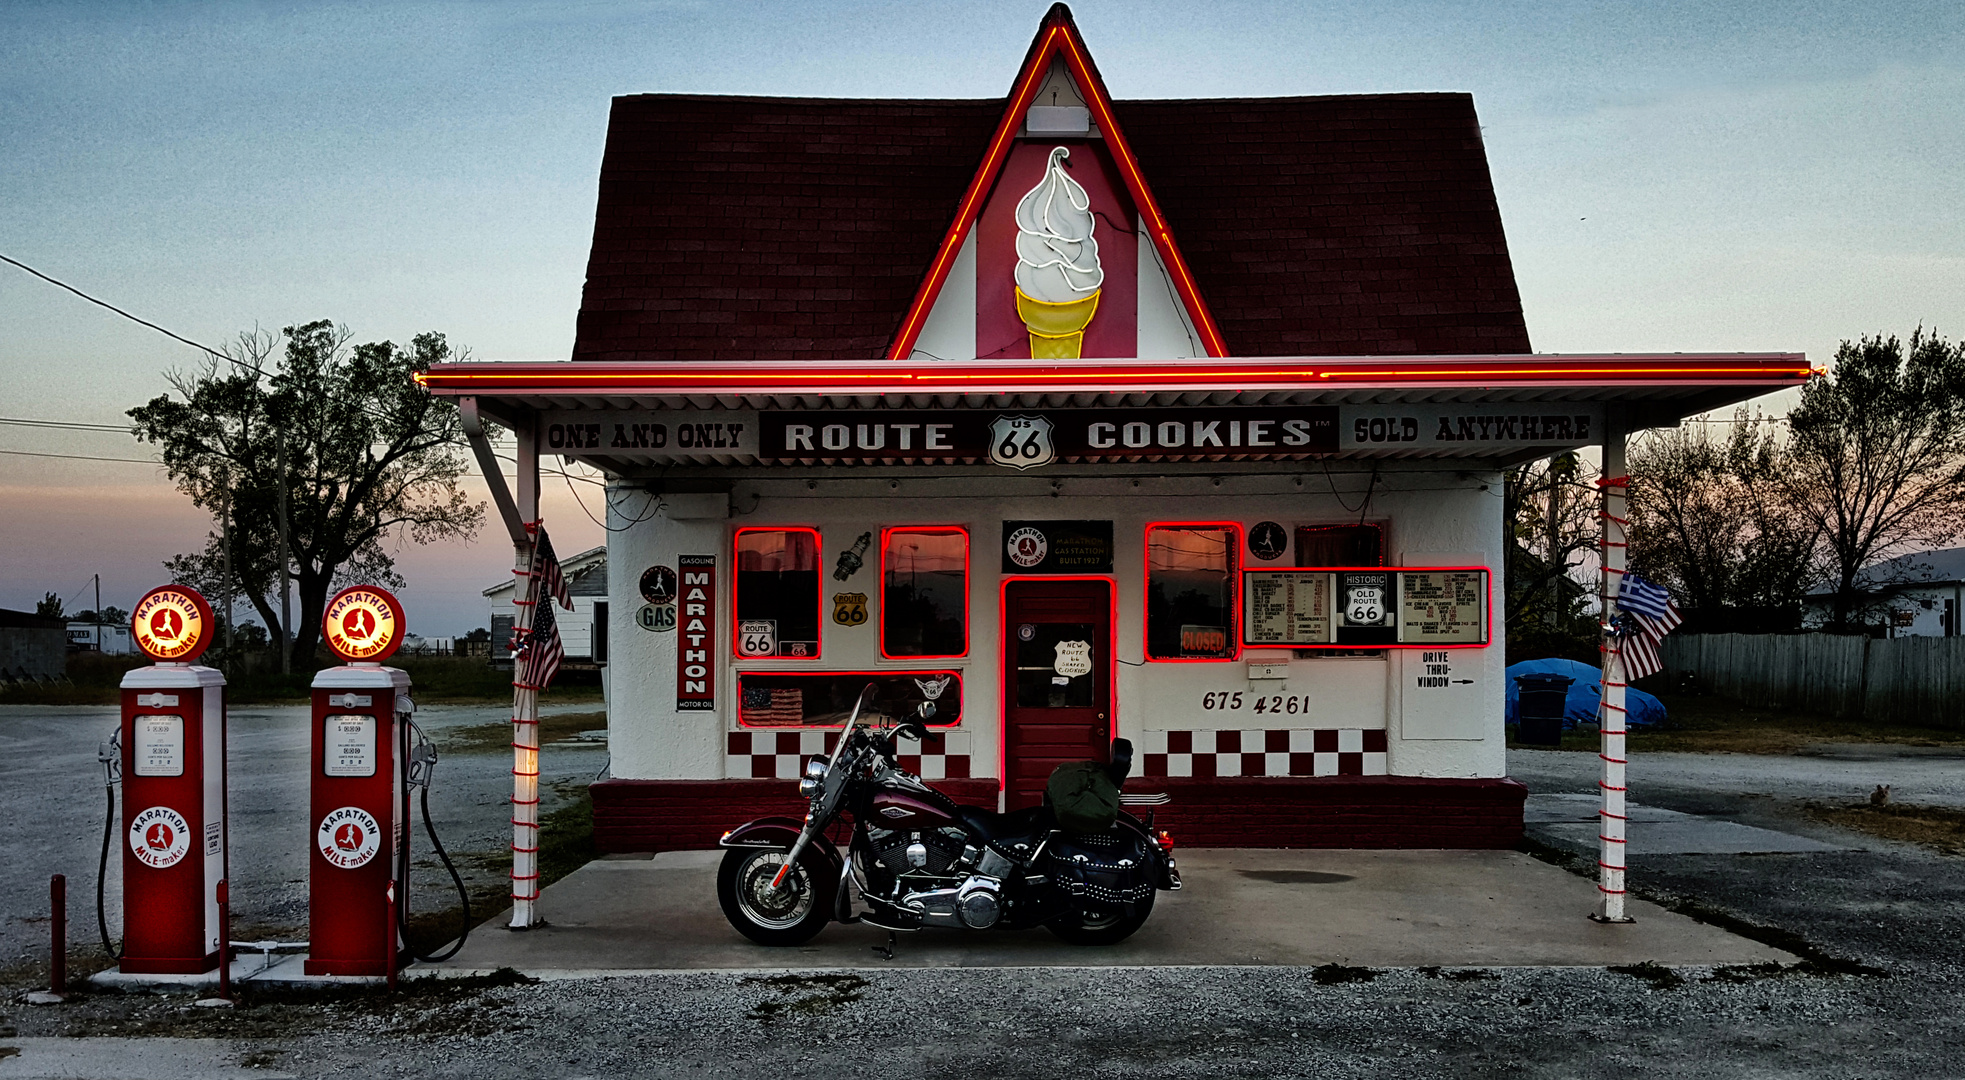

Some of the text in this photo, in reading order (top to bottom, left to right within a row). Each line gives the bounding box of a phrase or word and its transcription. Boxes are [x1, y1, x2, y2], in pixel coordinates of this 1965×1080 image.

[1011, 420, 1032, 429] US
[1088, 419, 1311, 448] COOKIES
[1354, 415, 1591, 443] SOLD ANYWHERE
[548, 423, 744, 449] ONE AND ONLY
[785, 424, 953, 450] ROUTE
[998, 429, 1041, 460] 66
[1009, 528, 1046, 546] MARATHON
[680, 557, 715, 565] GASOLINE
[1011, 549, 1045, 565] MILE-maker
[1054, 547, 1105, 555] GAS STATION
[1059, 557, 1081, 565] BUILT
[1346, 575, 1385, 584] HISTORIC
[839, 595, 863, 603] ROUTE
[1356, 590, 1375, 598] OLD
[138, 592, 199, 620] MARATHON
[330, 592, 392, 620] MARATHON
[836, 604, 864, 623] 66
[1353, 606, 1378, 620] 66
[643, 606, 676, 627] GAS
[684, 572, 709, 693] MARATHON
[1182, 631, 1224, 651] CLOSED
[140, 631, 197, 656] MILE-maker
[331, 631, 389, 656] MILE-maker
[745, 634, 770, 652] 66
[793, 648, 805, 656] 66
[1422, 651, 1449, 663] DRIVE
[1417, 676, 1449, 688] WINDOW
[1202, 691, 1310, 715] 675 4261
[132, 809, 187, 834] MARATHON
[321, 809, 377, 835] MARATHON
[135, 845, 185, 865] MILE-maker
[322, 845, 375, 866] MILE-maker
